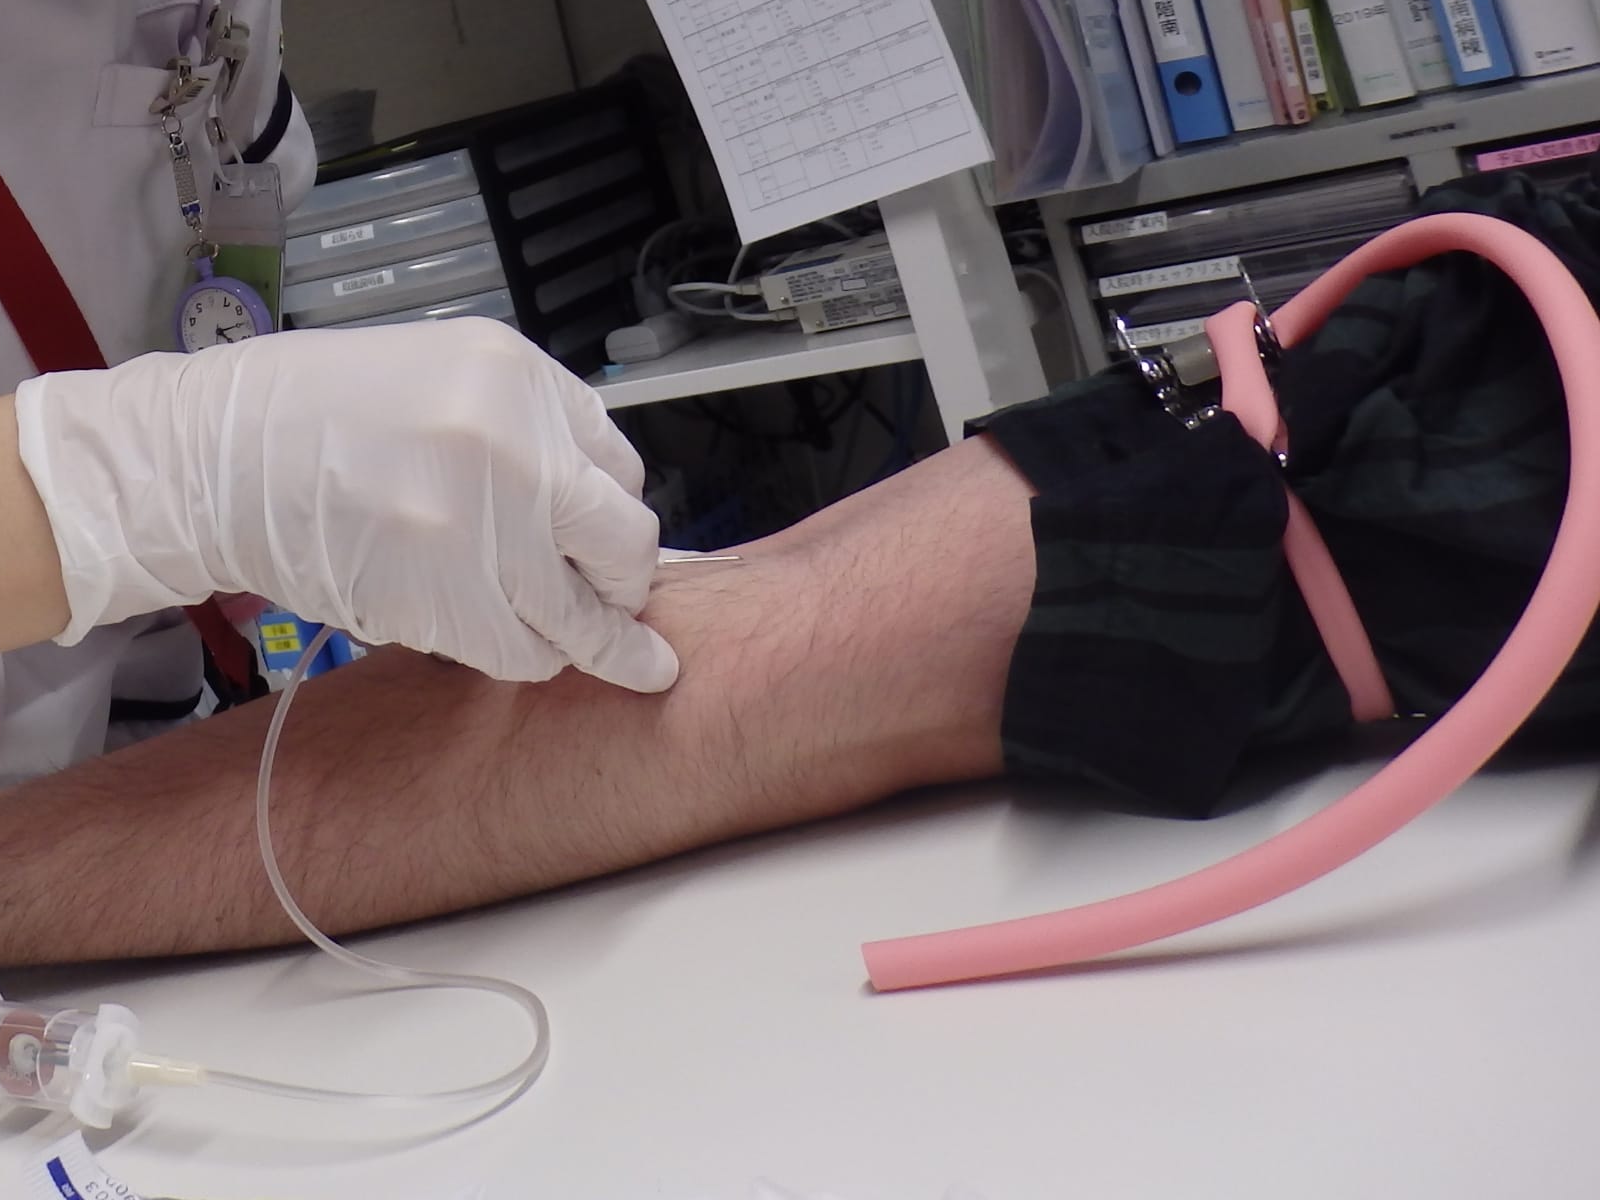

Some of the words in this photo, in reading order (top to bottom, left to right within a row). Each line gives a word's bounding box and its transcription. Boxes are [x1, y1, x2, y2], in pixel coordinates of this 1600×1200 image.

[223, 297, 230, 307] 7
[235, 305, 242, 315] 8
[189, 317, 196, 326] 4
